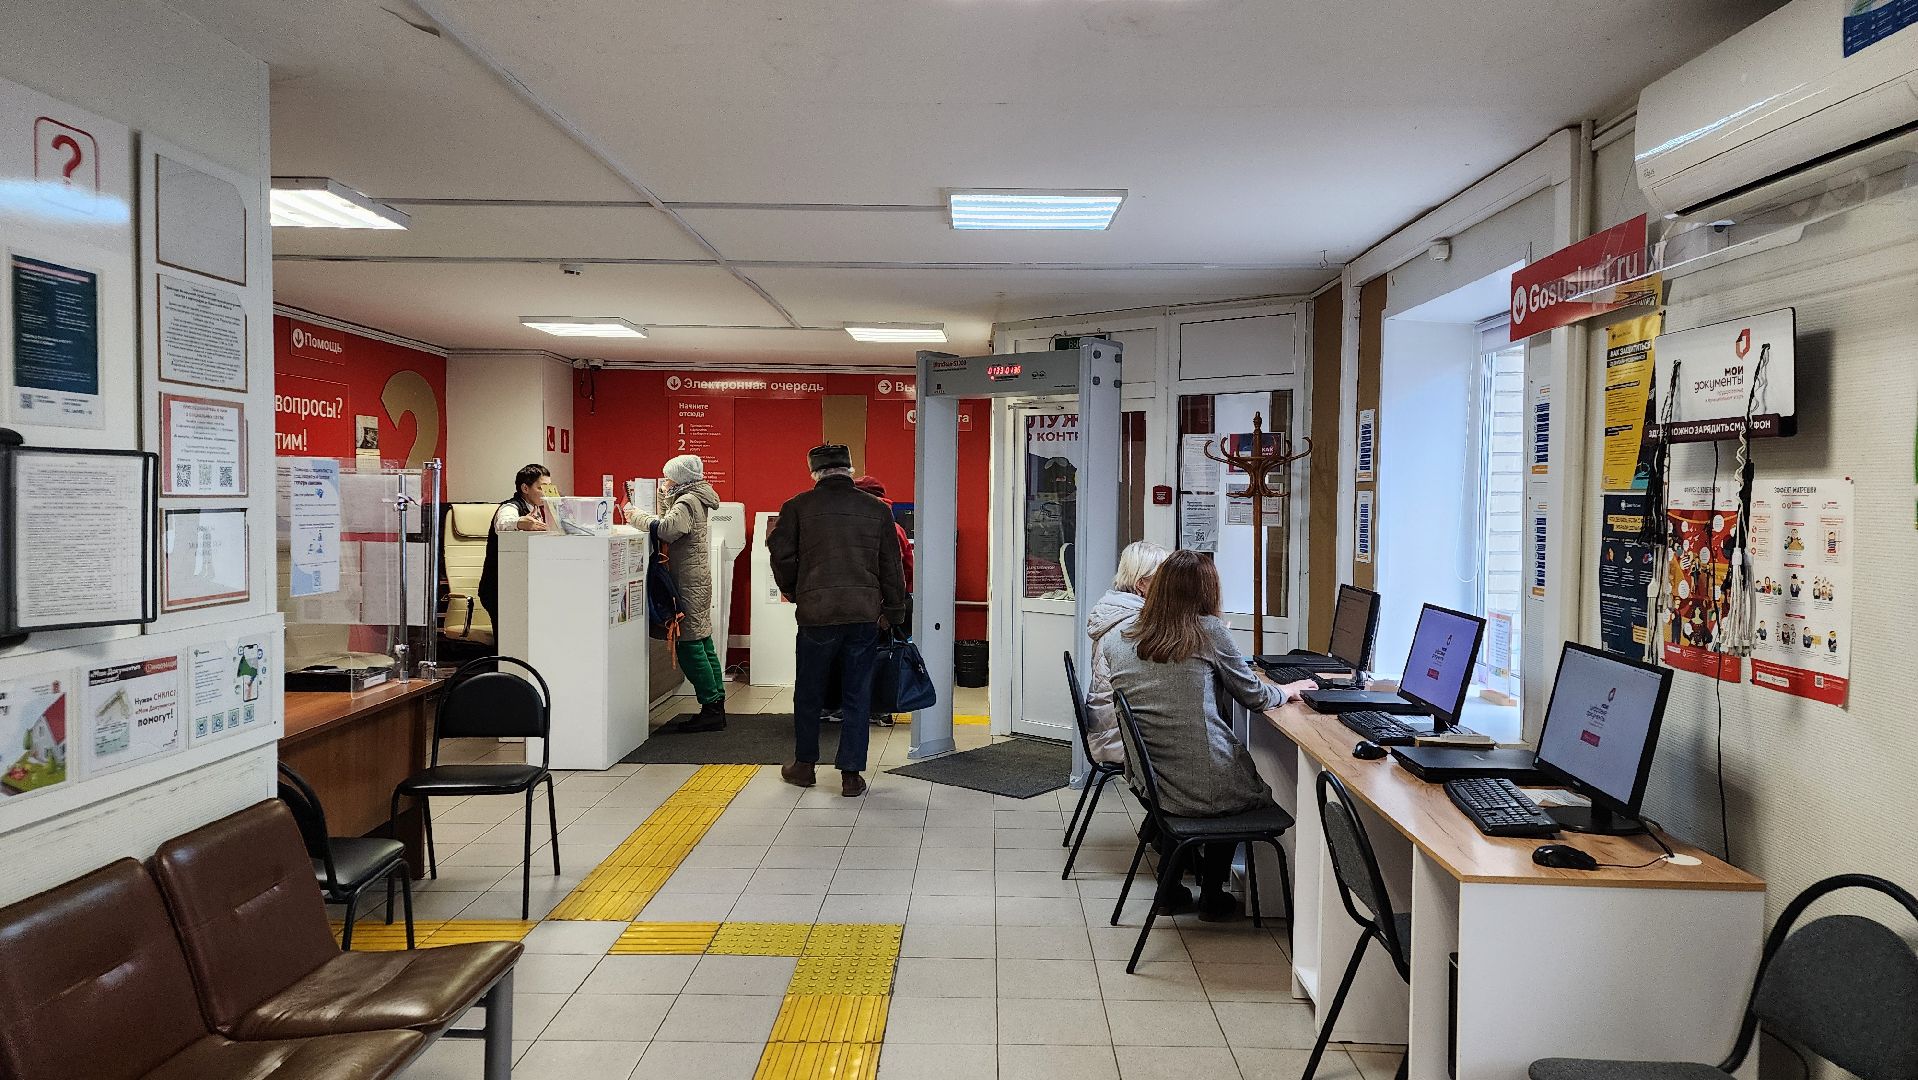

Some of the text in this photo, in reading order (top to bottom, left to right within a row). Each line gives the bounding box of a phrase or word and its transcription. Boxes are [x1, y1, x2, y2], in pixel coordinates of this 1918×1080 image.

[304, 332, 343, 354] Помощь
[683, 377, 824, 393] Электронная очередь
[1694, 376, 1744, 394] документы
[275, 395, 343, 420] вопросы?
[679, 402, 709, 410] Начните
[678, 423, 686, 435] 1
[1671, 427, 1694, 437] ОЖНО
[1694, 423, 1730, 435] ЗАРЯДИТЬ
[1729, 419, 1771, 432] СМАФОН
[678, 439, 686, 451] 2
[137, 708, 174, 727] помогут!
